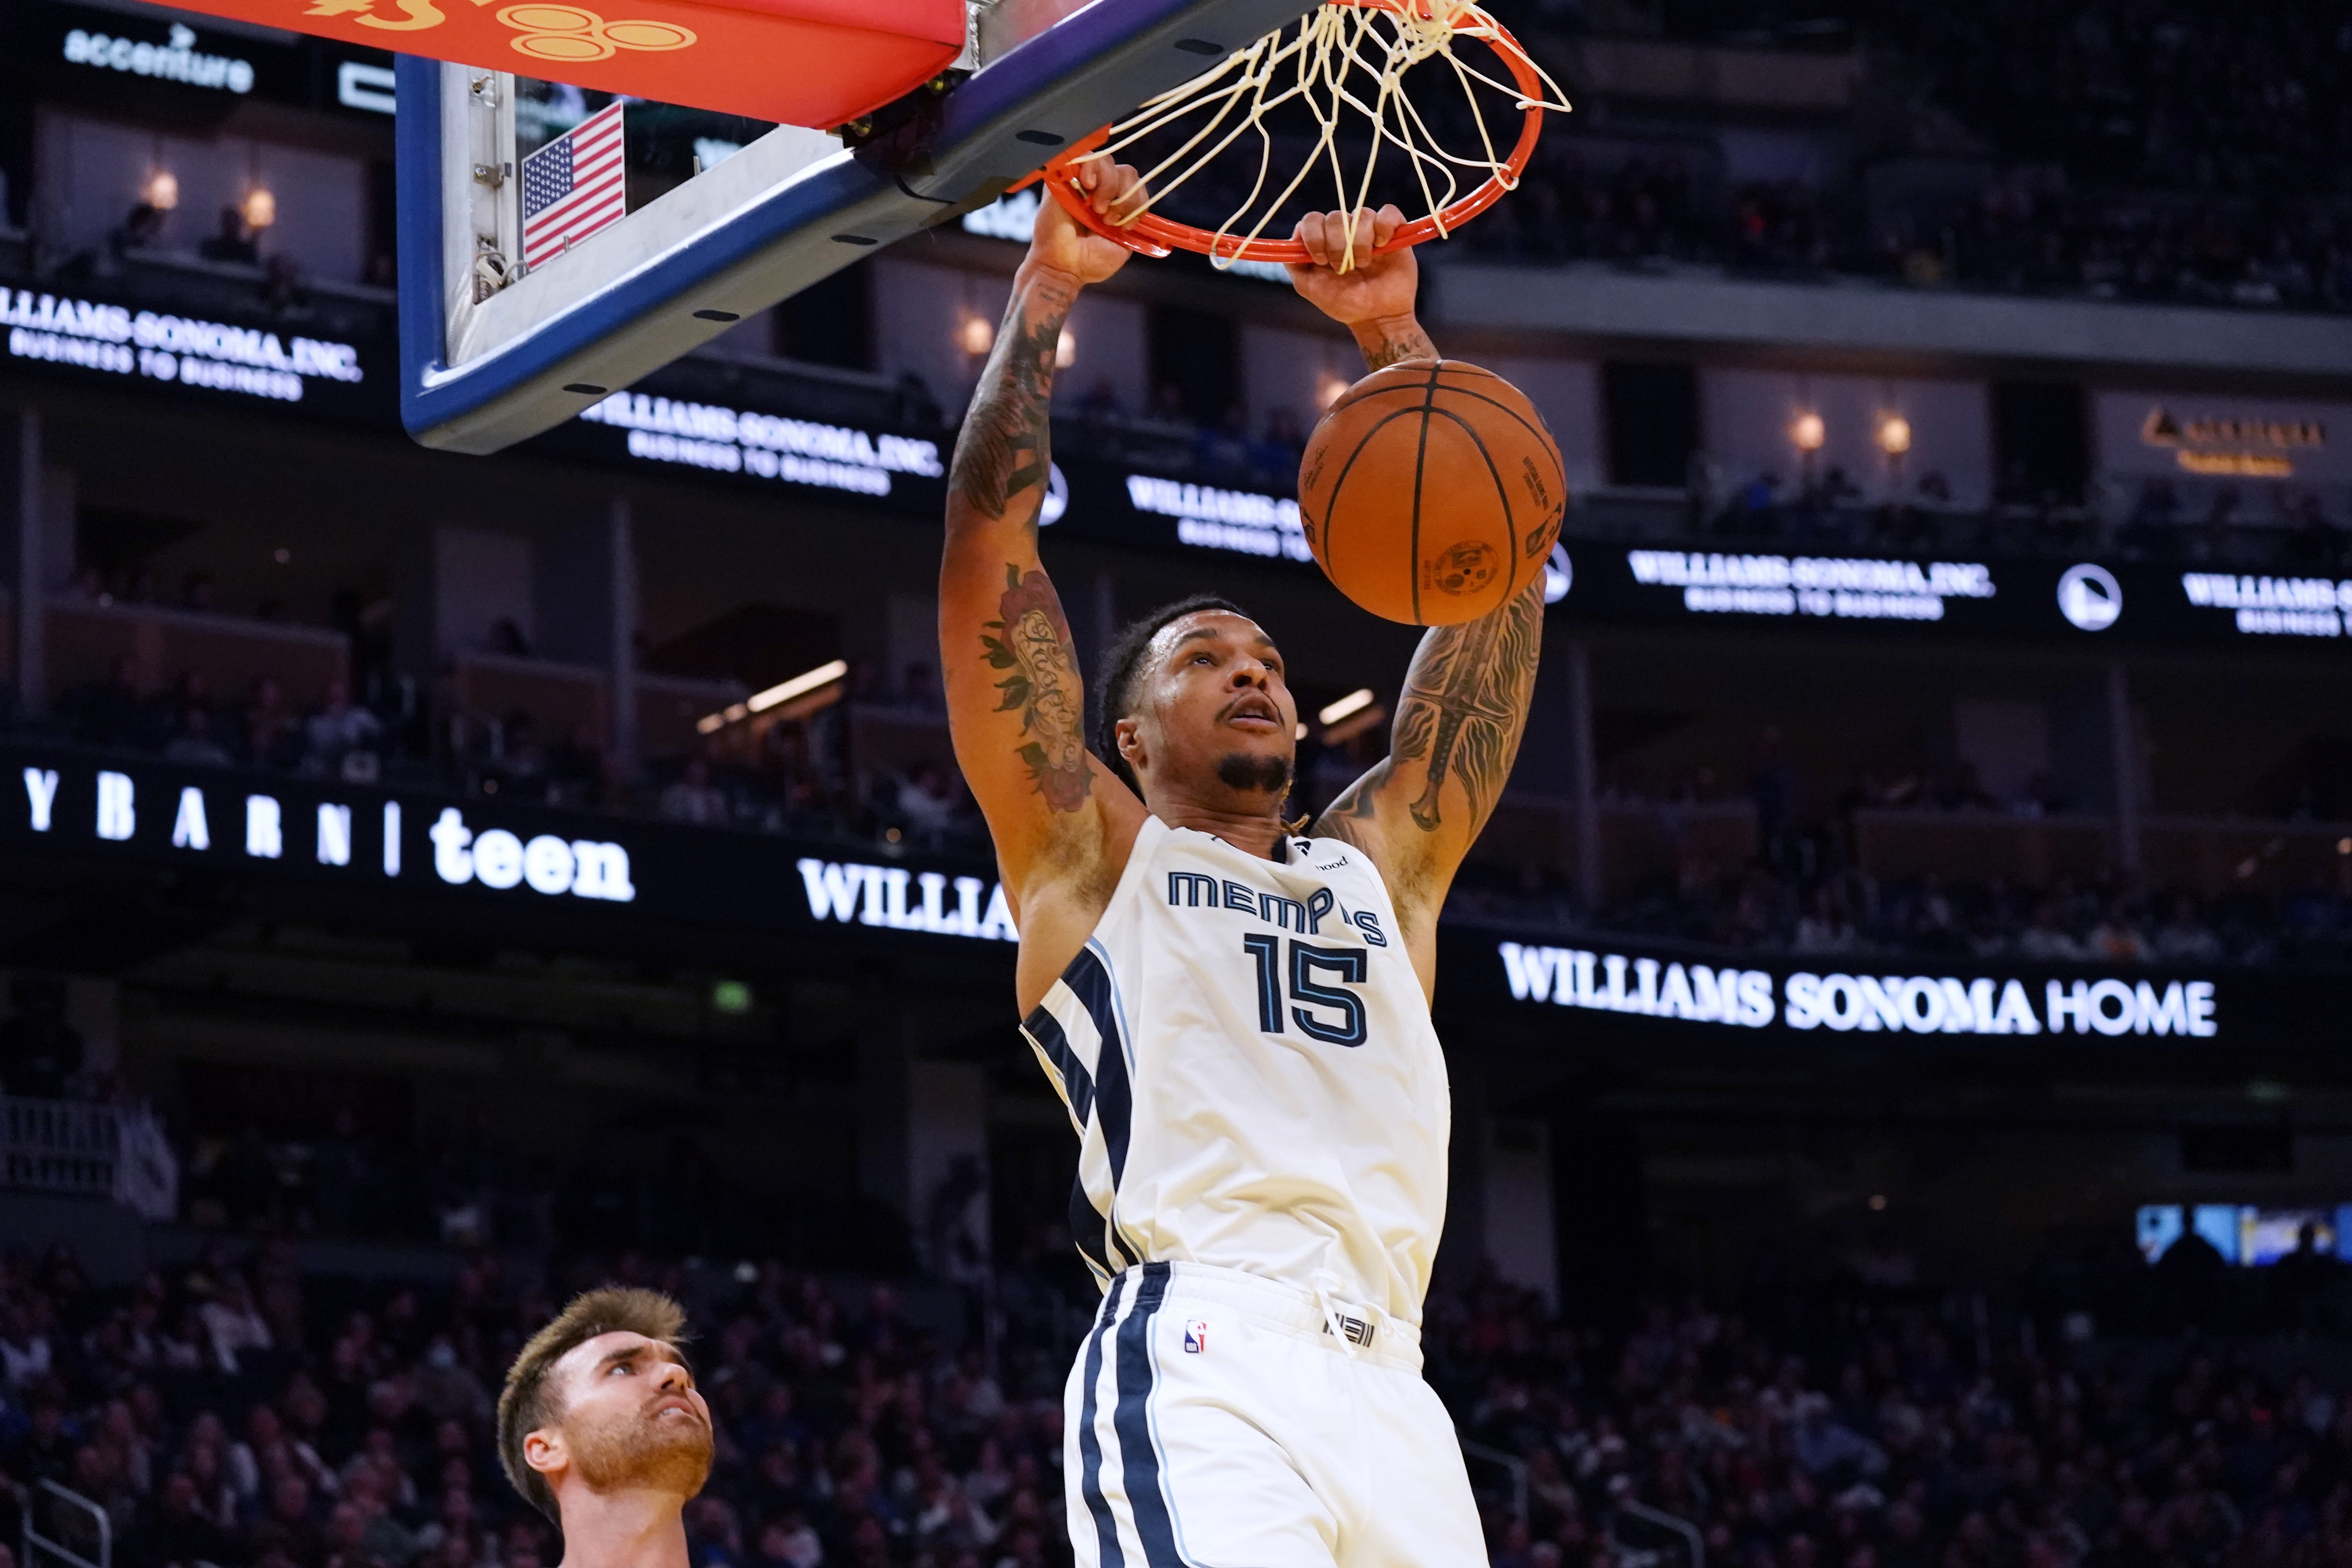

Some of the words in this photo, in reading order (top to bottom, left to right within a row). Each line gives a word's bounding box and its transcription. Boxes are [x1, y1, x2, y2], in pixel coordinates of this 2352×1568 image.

[63, 29, 255, 94] accenture
[9, 326, 134, 374] BUSINESS
[139, 347, 178, 381] TO
[180, 355, 303, 402] BUSINESS
[628, 431, 742, 473] BUSINESS
[744, 446, 779, 478] TO
[781, 456, 891, 496] BUSINESS
[1684, 588, 1796, 615] BUSINESS
[1798, 589, 1832, 616] TO
[1835, 592, 1944, 620] BUSINESS
[2236, 610, 2341, 637] BUSINESS
[429, 808, 635, 902] teen
[797, 857, 1020, 942] WILLIA
[1168, 871, 1388, 948] MEMPS
[1244, 933, 1367, 1047] 15
[1499, 942, 1774, 1028] WILLIAMS
[1785, 974, 2041, 1035] SONOMA
[2047, 979, 2217, 1037] HOME
